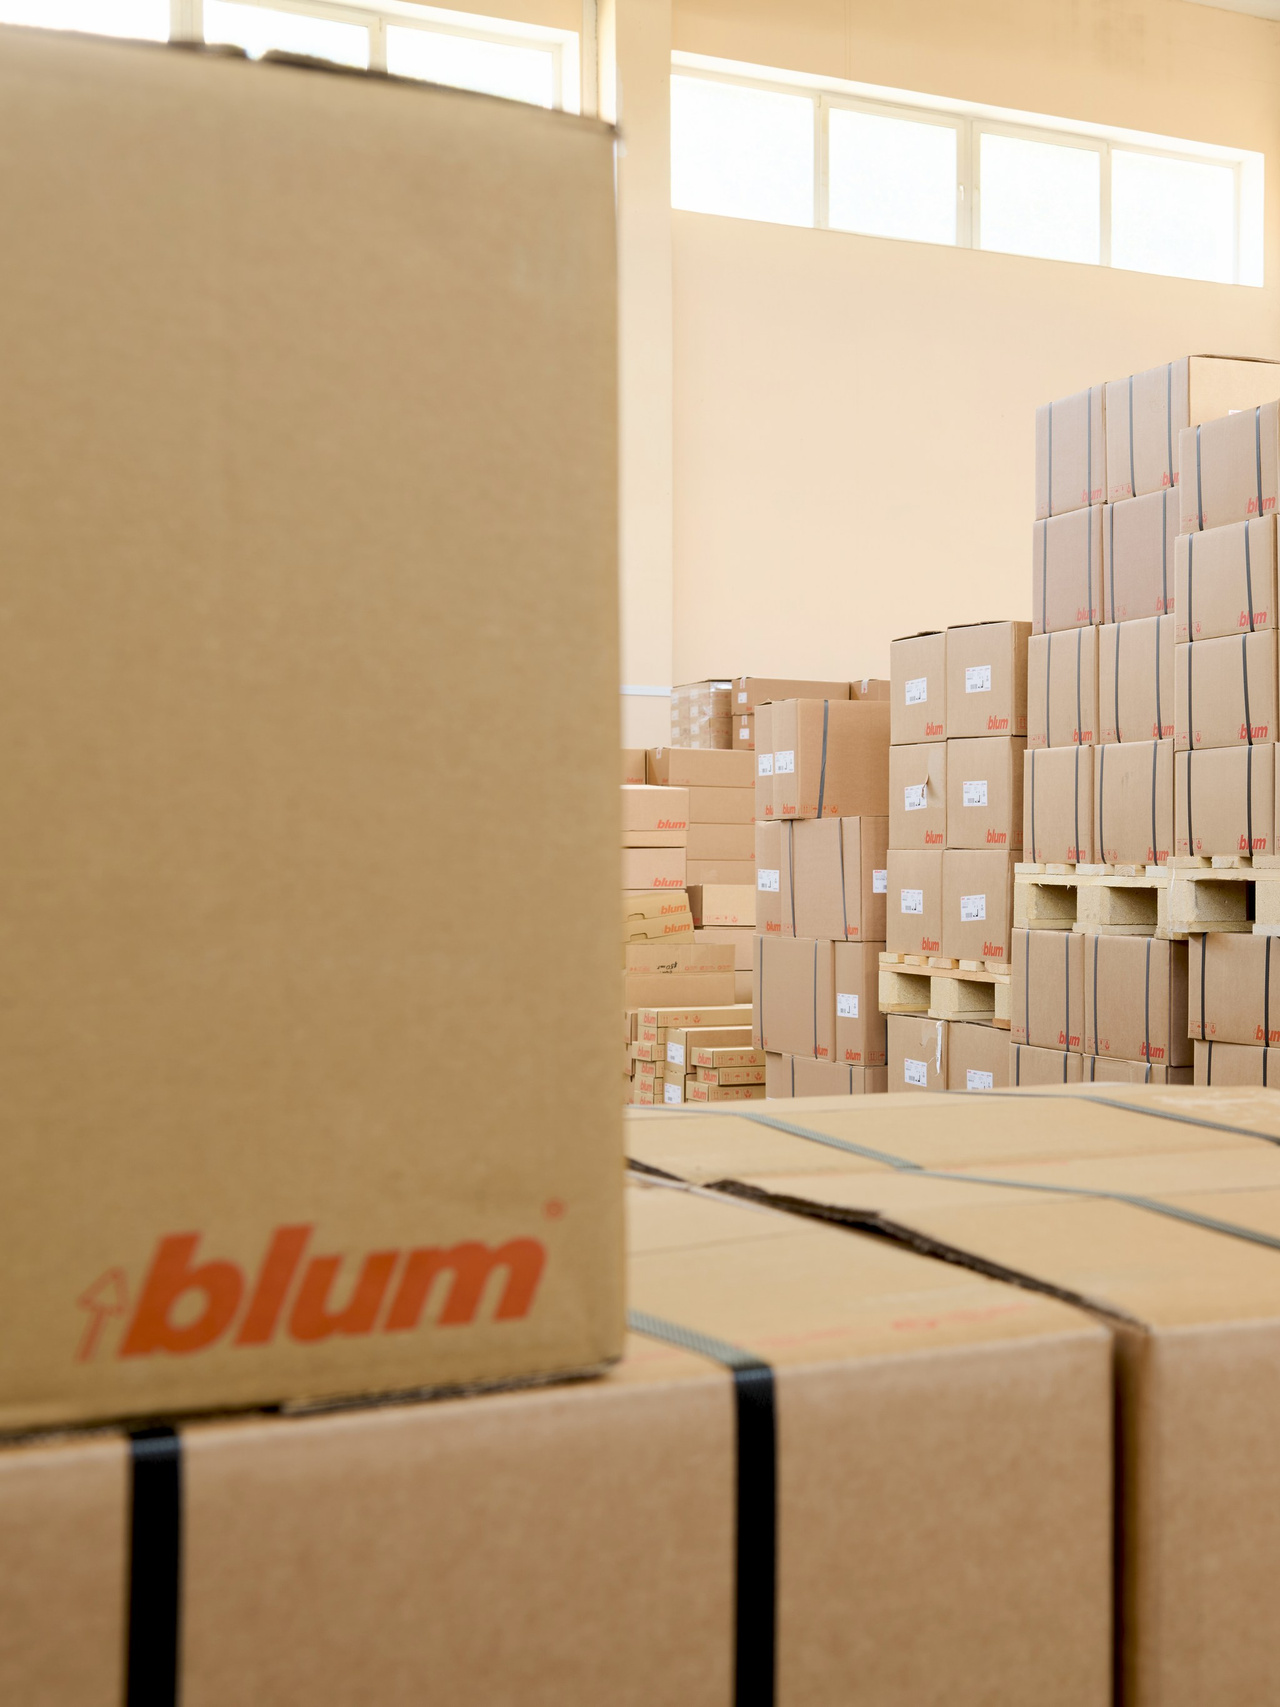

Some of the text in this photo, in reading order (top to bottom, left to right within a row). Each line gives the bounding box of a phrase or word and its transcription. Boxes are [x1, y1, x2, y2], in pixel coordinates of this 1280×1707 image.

[1082, 489, 1102, 502] bum
[925, 722, 943, 736] blum
[988, 715, 1008, 730] blum
[1073, 729, 1092, 742] bum
[1152, 723, 1174, 737] bum
[1240, 723, 1268, 739] bum
[658, 820, 687, 829] blum
[925, 830, 942, 844] blum
[986, 829, 1007, 843] blum
[1239, 834, 1267, 850] bum
[1147, 848, 1169, 861] bum
[654, 877, 683, 887] blum
[660, 904, 687, 915] blum
[664, 923, 690, 934] blum
[766, 921, 781, 931] blum
[921, 936, 940, 951] blum
[983, 942, 1003, 957] blum
[1058, 1031, 1080, 1046] bum
[846, 1049, 861, 1060] blum
[117, 1223, 547, 1359] blum
